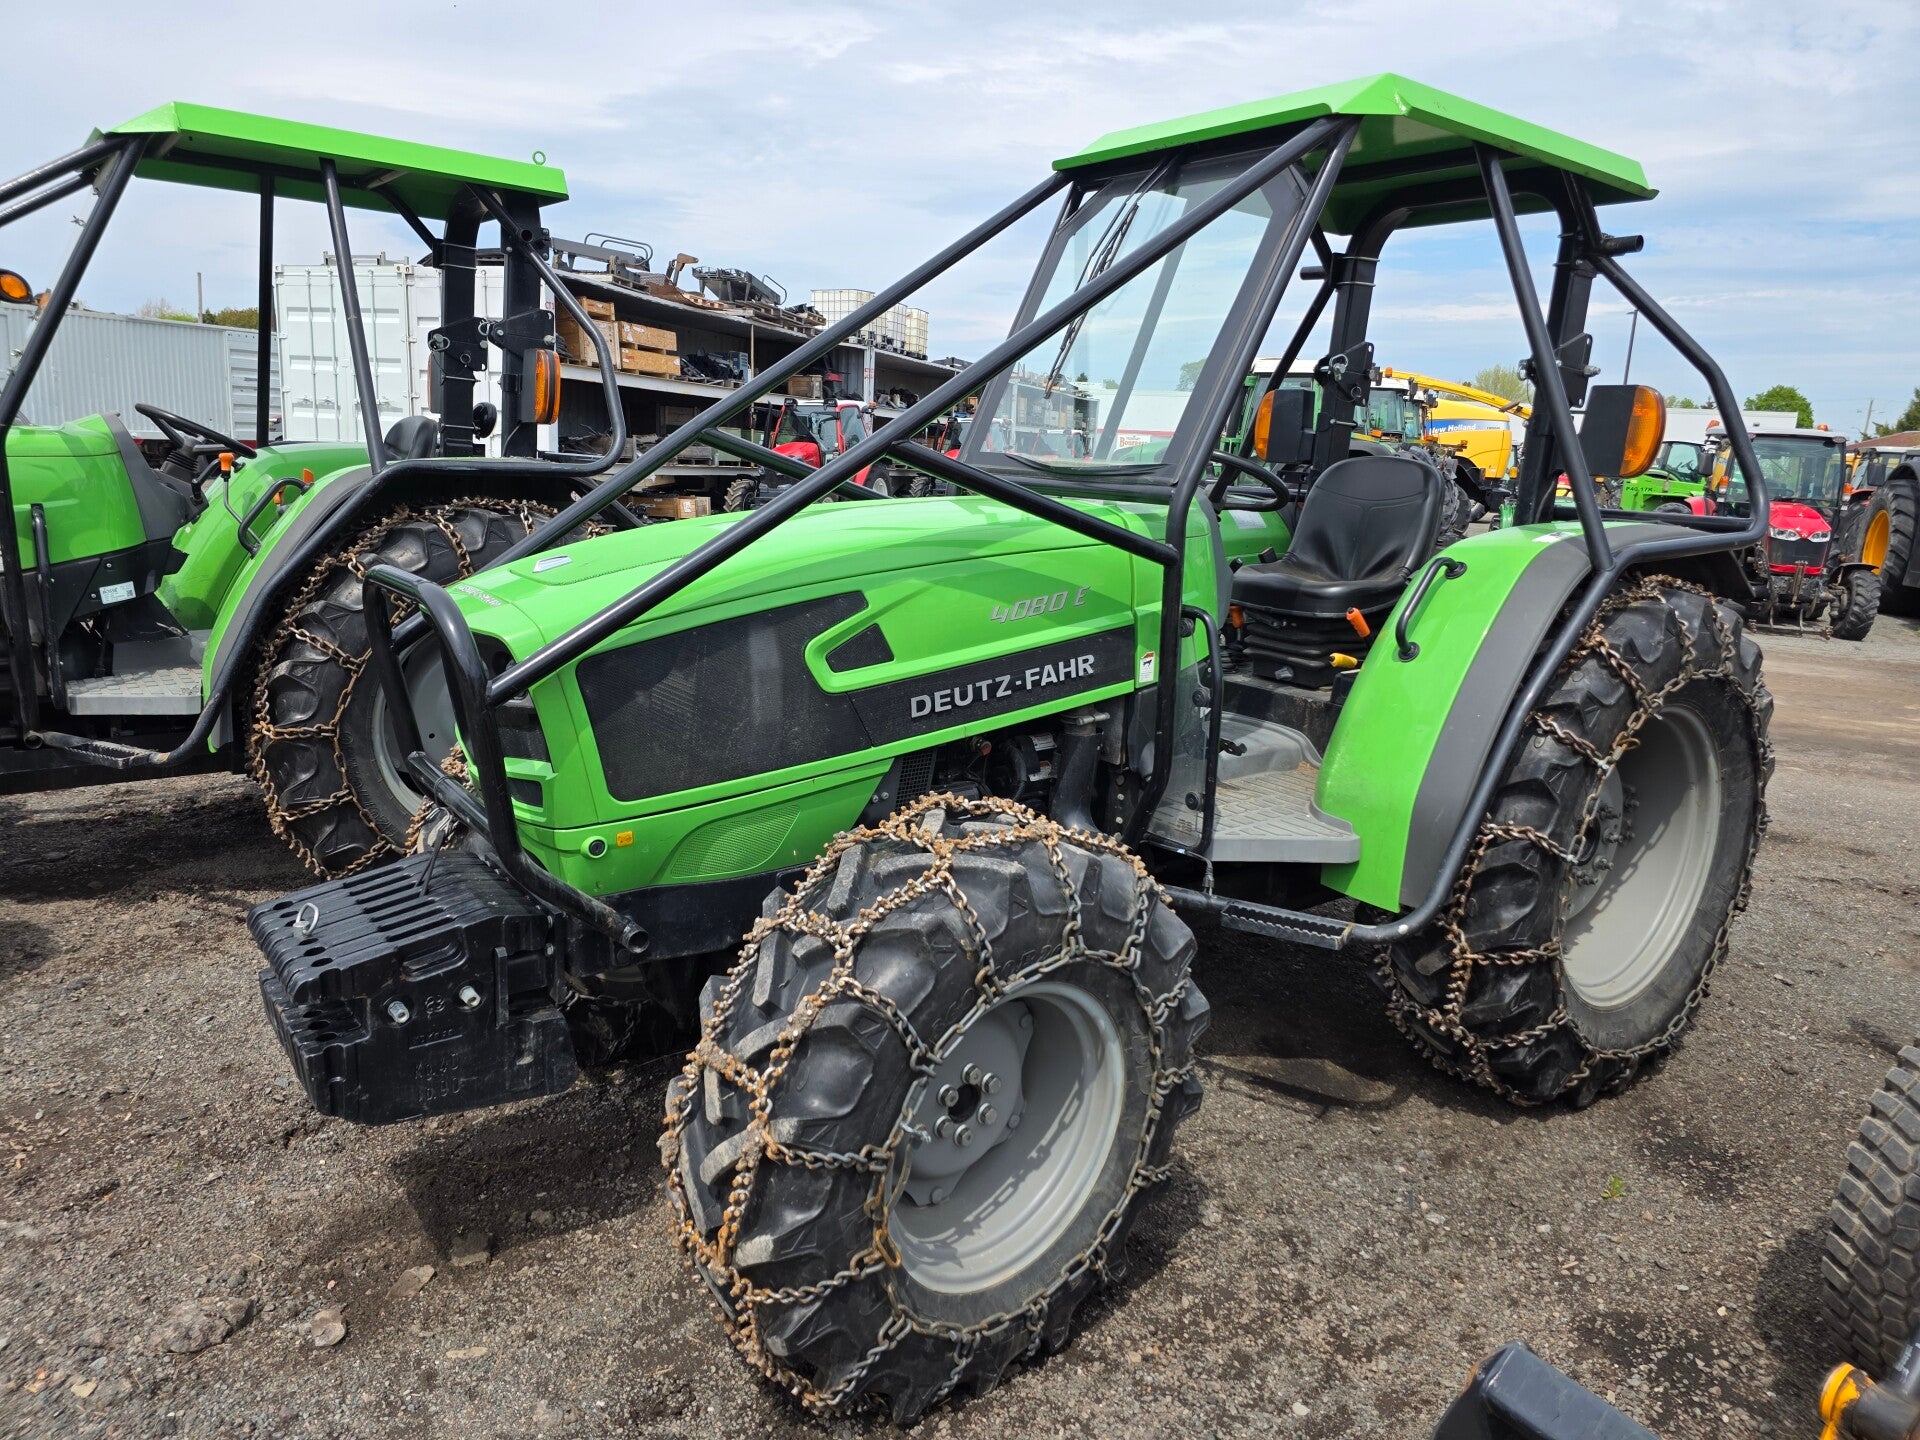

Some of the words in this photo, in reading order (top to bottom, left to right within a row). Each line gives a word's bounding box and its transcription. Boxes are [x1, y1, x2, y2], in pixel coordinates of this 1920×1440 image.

[1429, 427, 1446, 435] New
[1448, 424, 1477, 432] Holland
[990, 591, 1068, 623] 4080
[1075, 586, 1091, 606] E
[910, 654, 1096, 718] DEUTZ-FAHR
